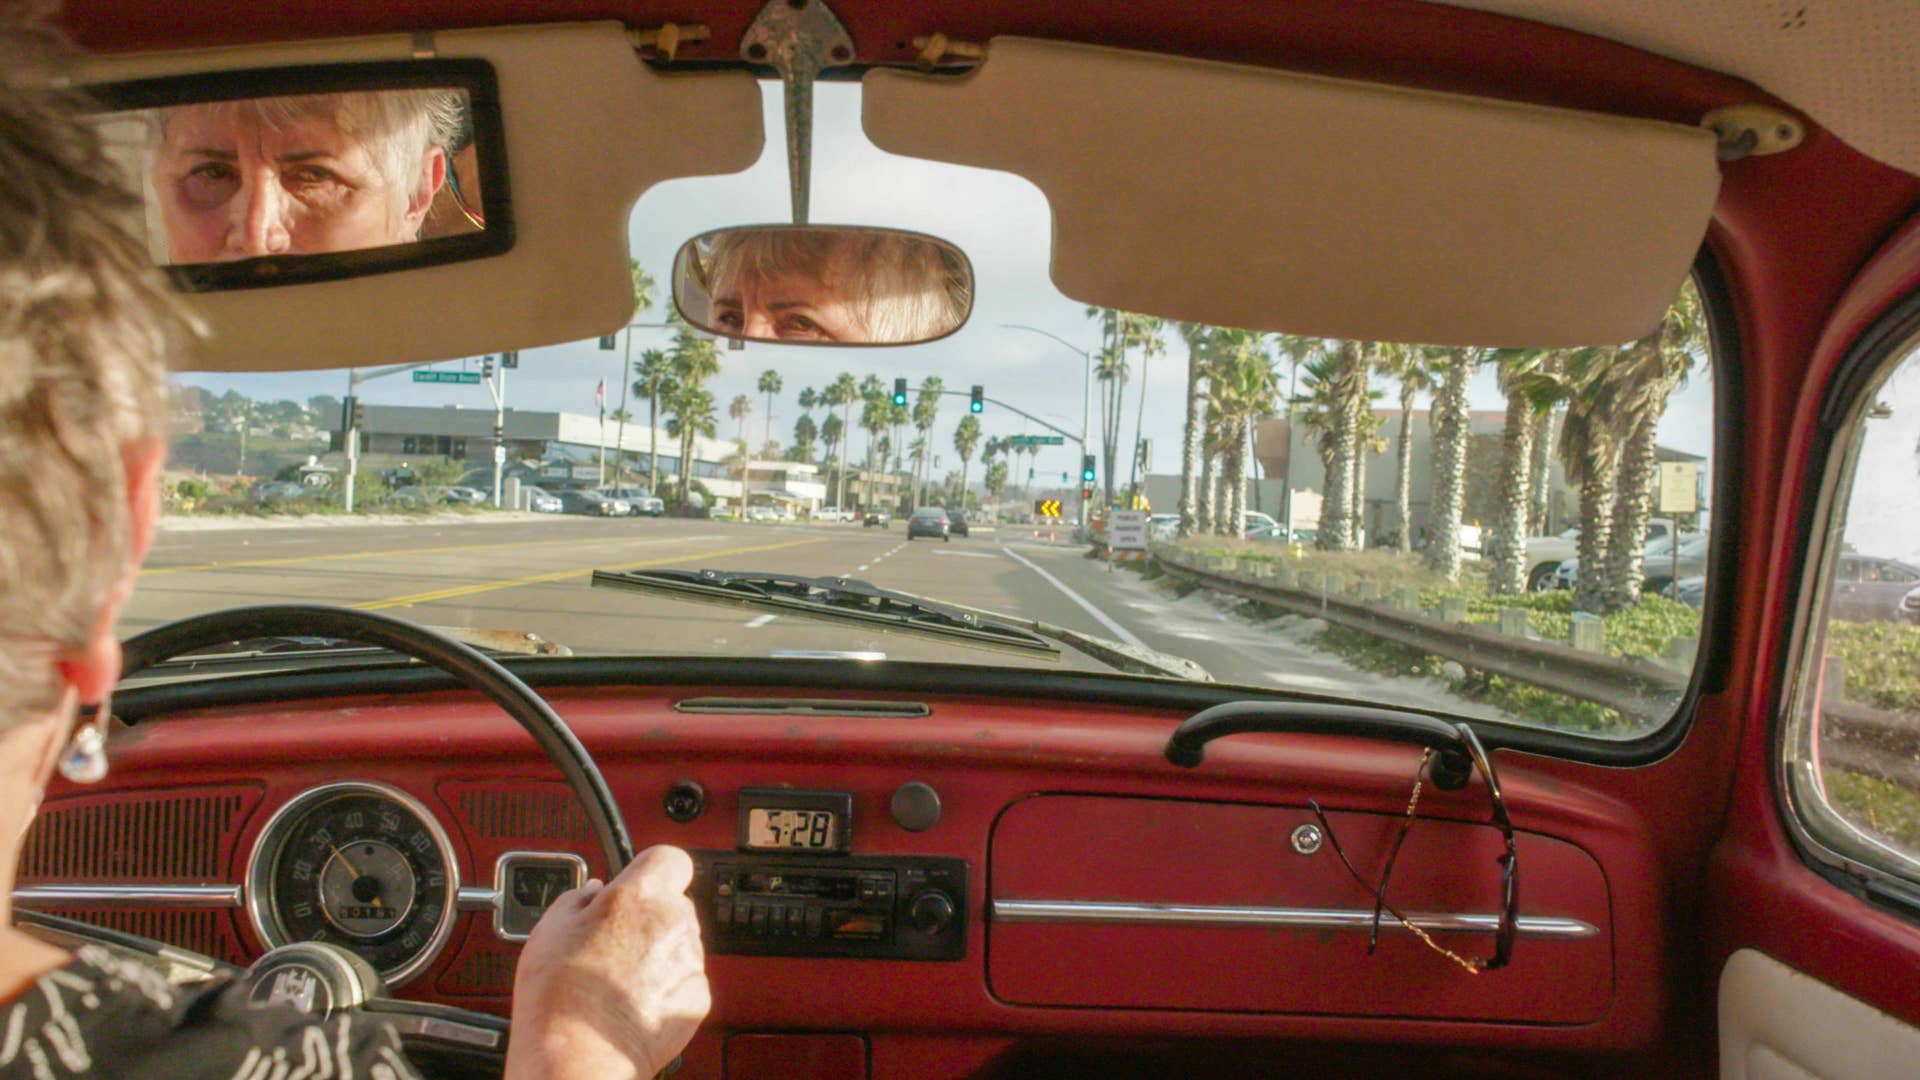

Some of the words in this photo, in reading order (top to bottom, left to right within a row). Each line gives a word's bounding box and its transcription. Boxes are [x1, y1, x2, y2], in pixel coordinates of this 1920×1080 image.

[344, 812, 364, 829] 40
[381, 810, 401, 832] 50
[765, 812, 830, 848] 5:28
[311, 828, 332, 849] 30
[410, 831, 431, 853] 60
[293, 861, 313, 881] 20
